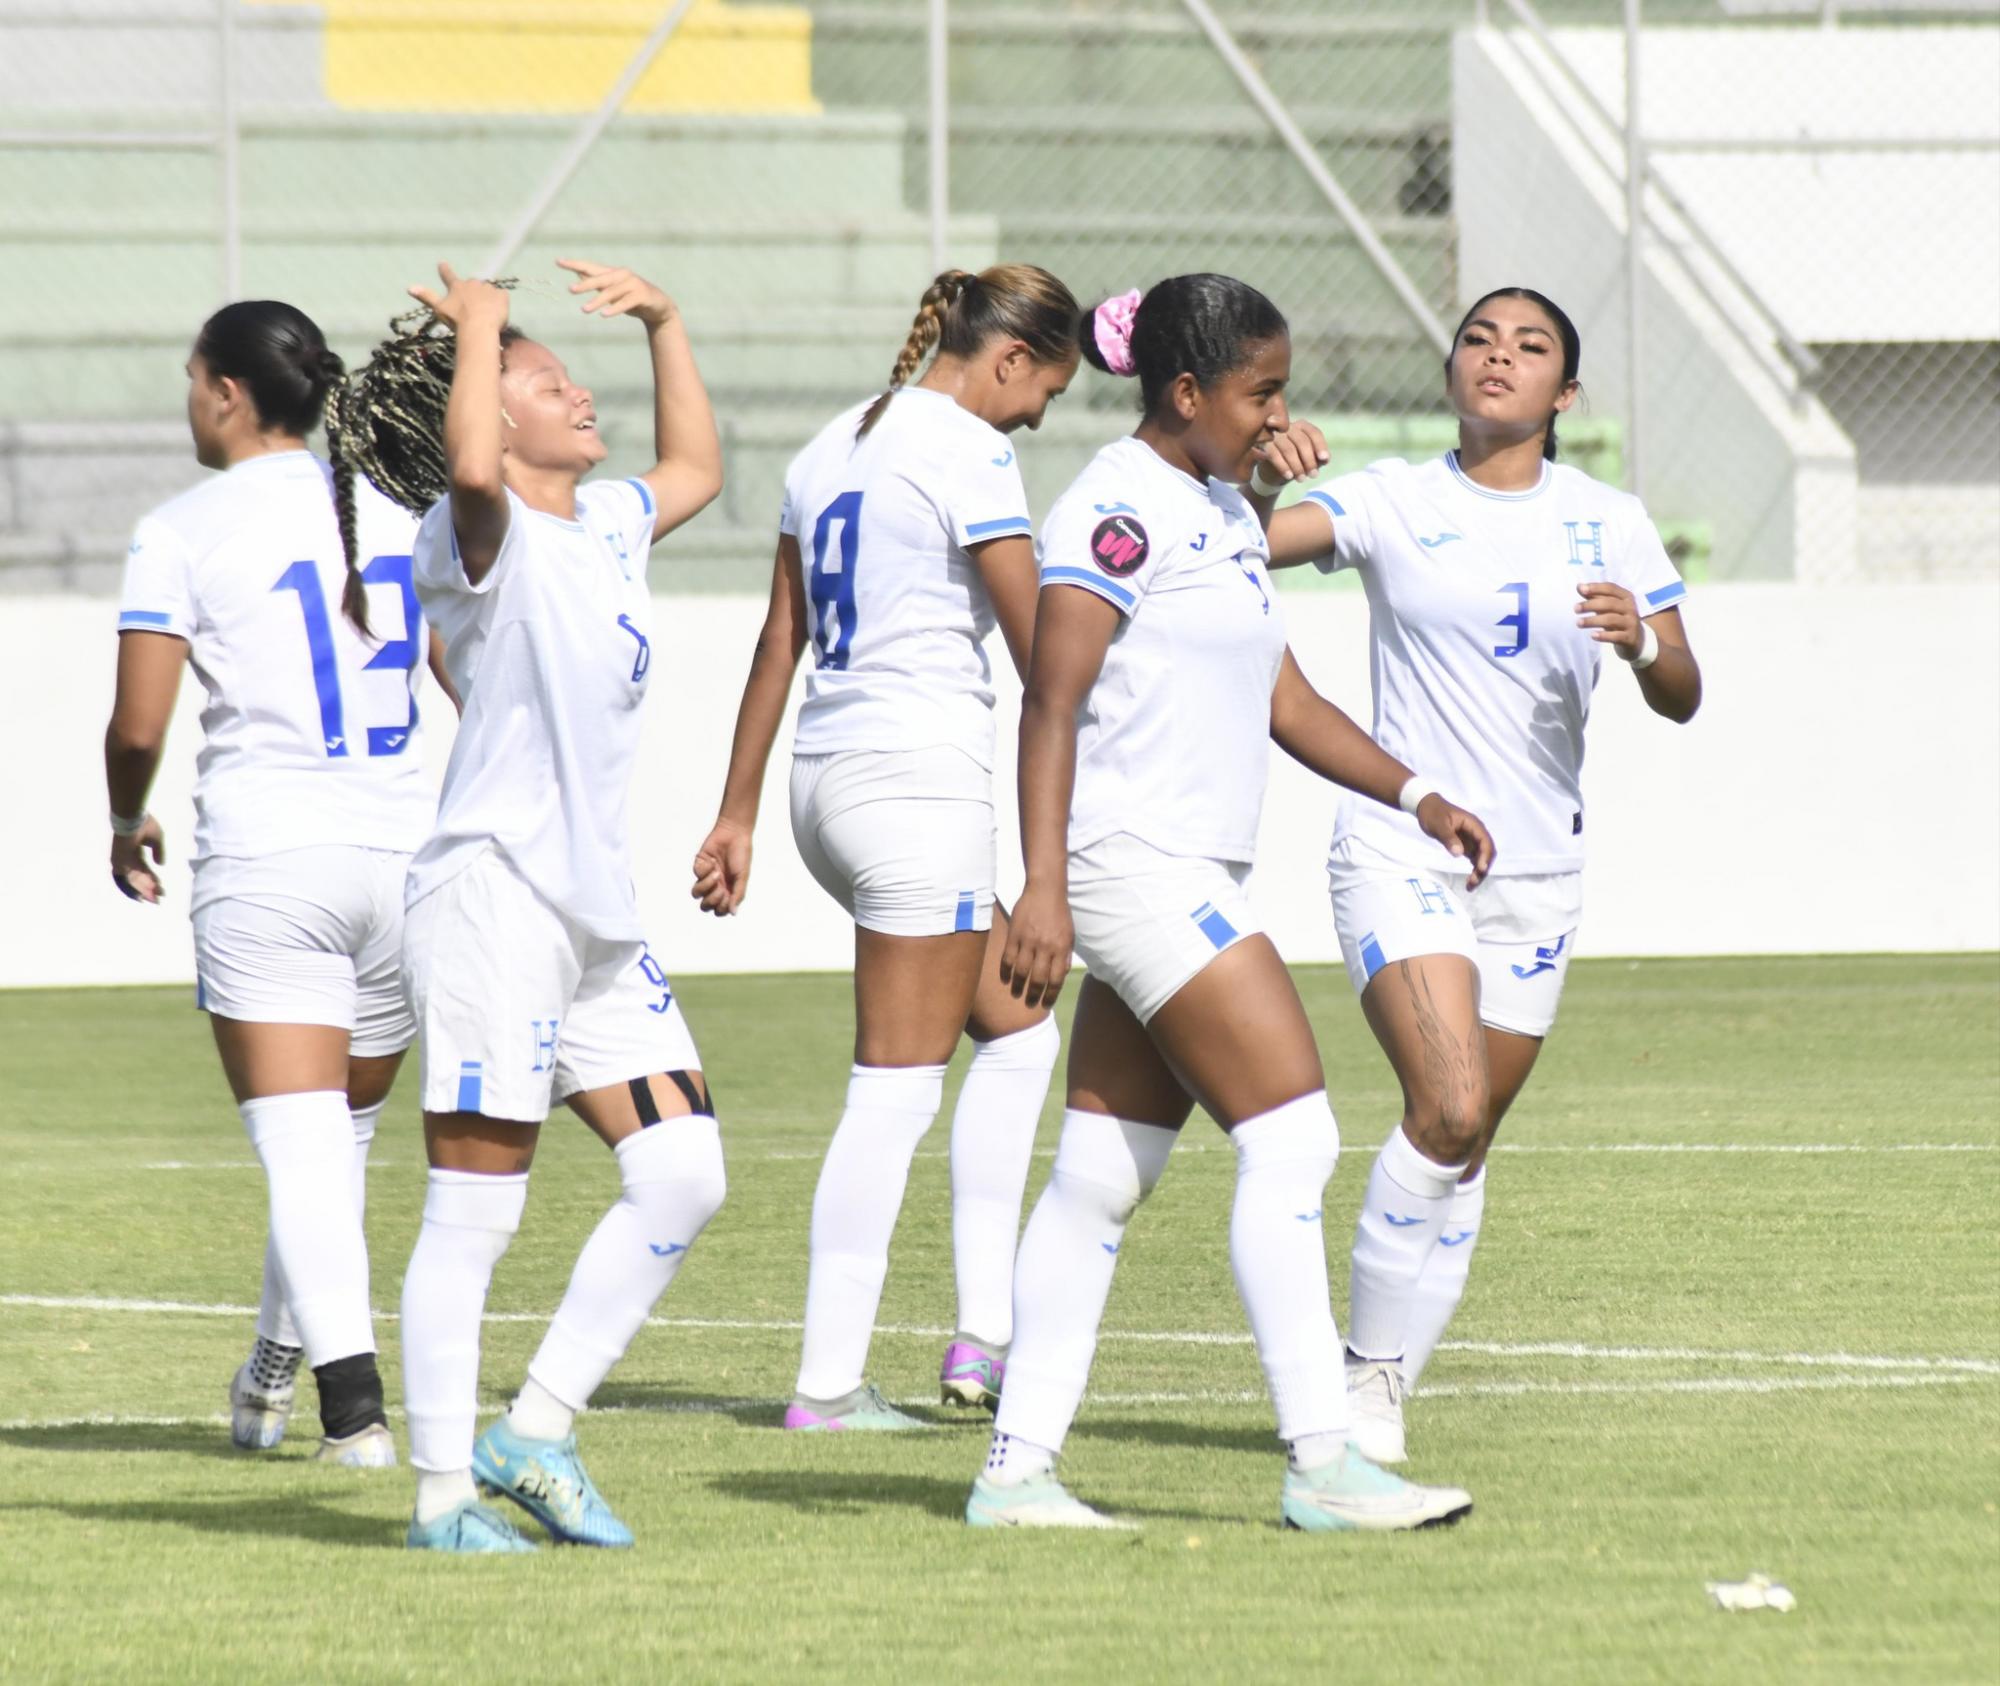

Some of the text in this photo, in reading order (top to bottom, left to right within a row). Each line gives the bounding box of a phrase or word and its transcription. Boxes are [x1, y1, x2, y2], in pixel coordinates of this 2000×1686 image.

[1562, 521, 1605, 567] H
[811, 490, 865, 671] 8
[1494, 582, 1529, 657] 3
[270, 554, 422, 758] 13
[1405, 878, 1455, 915] H
[531, 1020, 559, 1072] H
